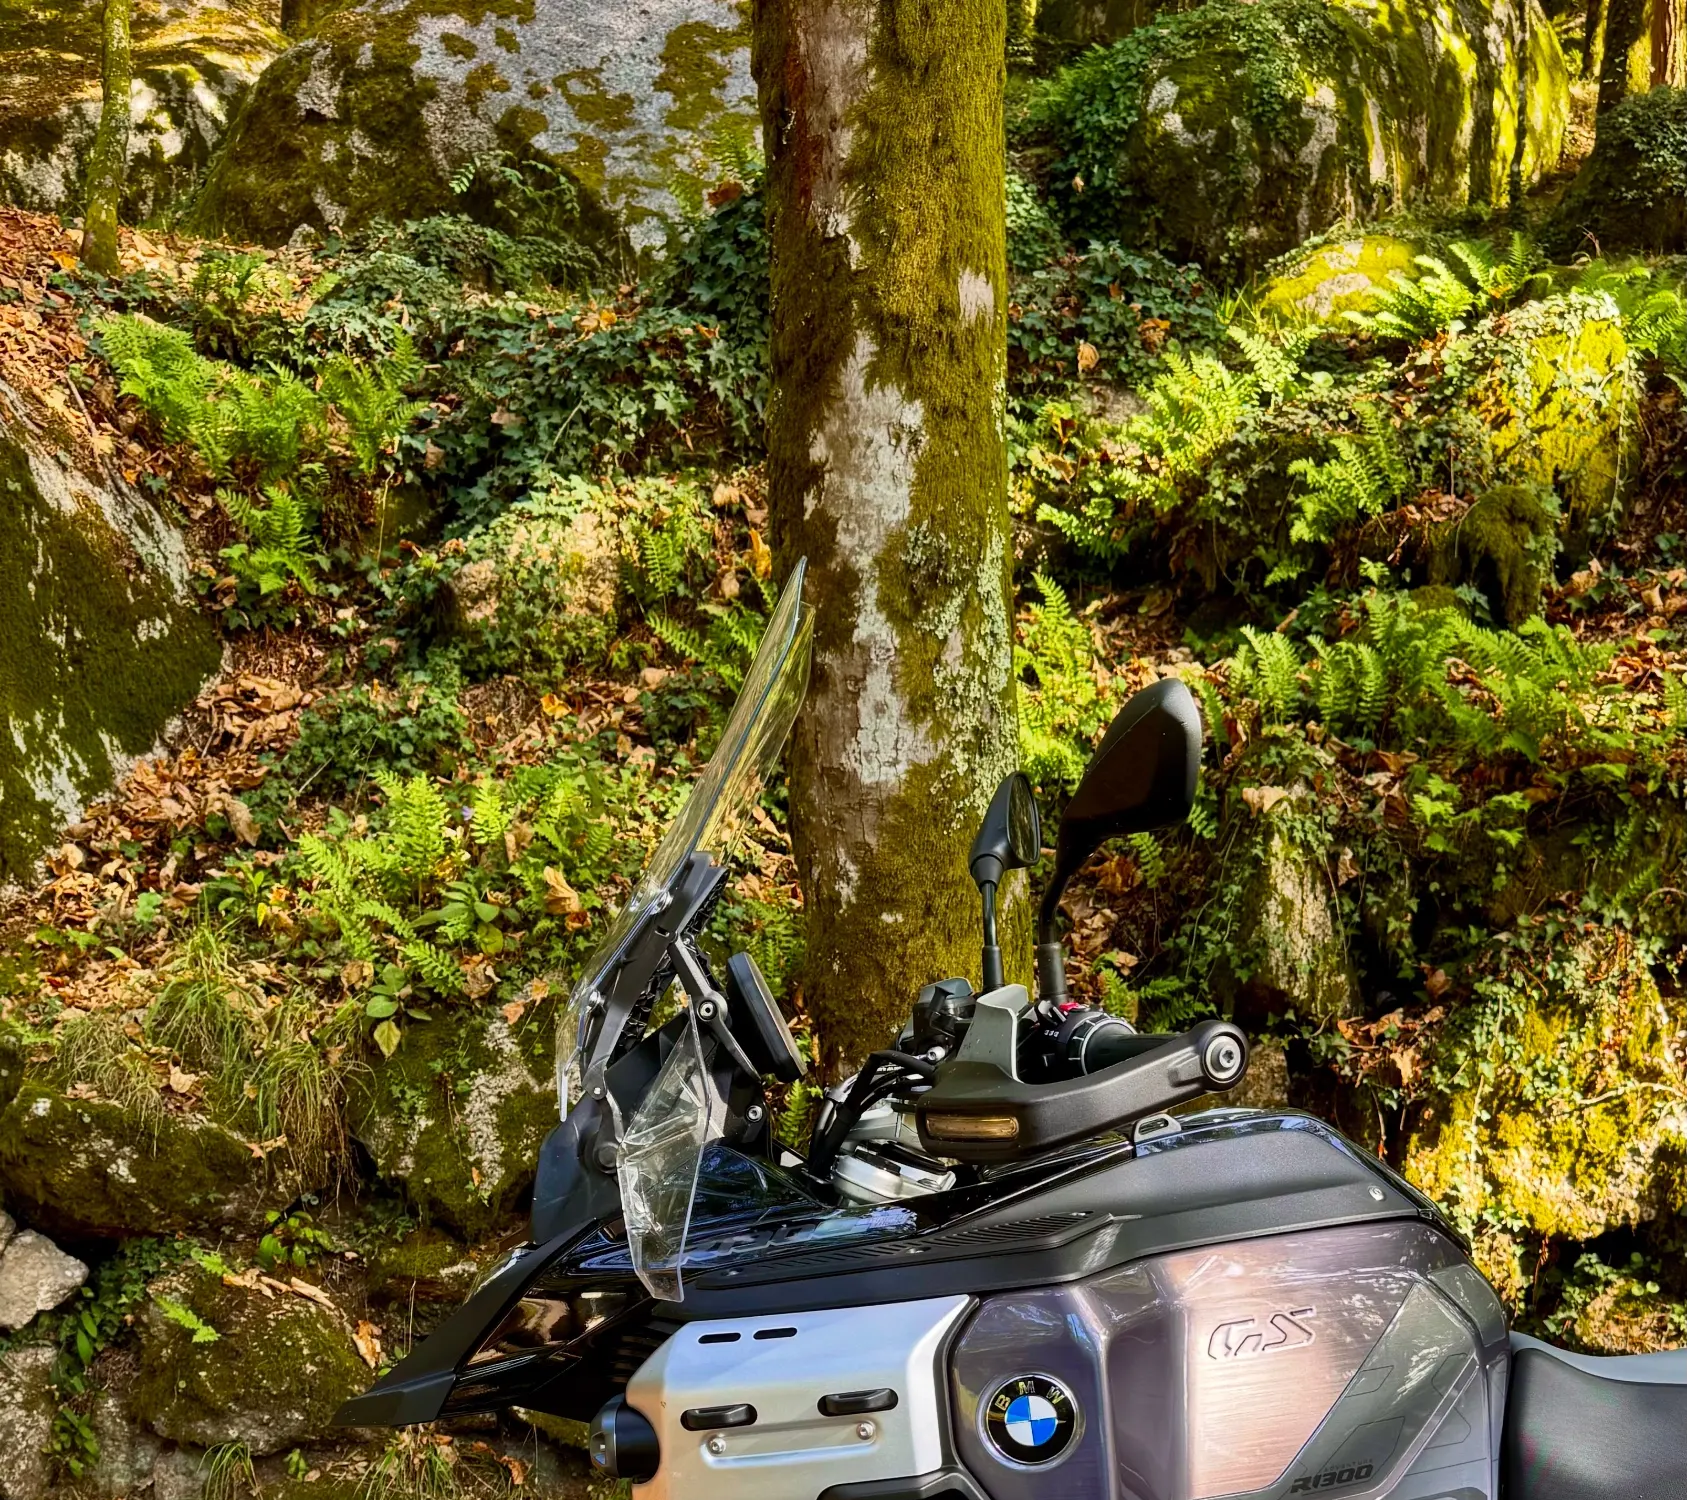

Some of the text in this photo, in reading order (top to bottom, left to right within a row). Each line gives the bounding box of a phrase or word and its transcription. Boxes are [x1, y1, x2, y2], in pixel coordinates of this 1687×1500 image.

[1207, 1307, 1314, 1360] GS
[994, 1380, 1066, 1411] BMW
[1290, 1464, 1374, 1493] R1300
